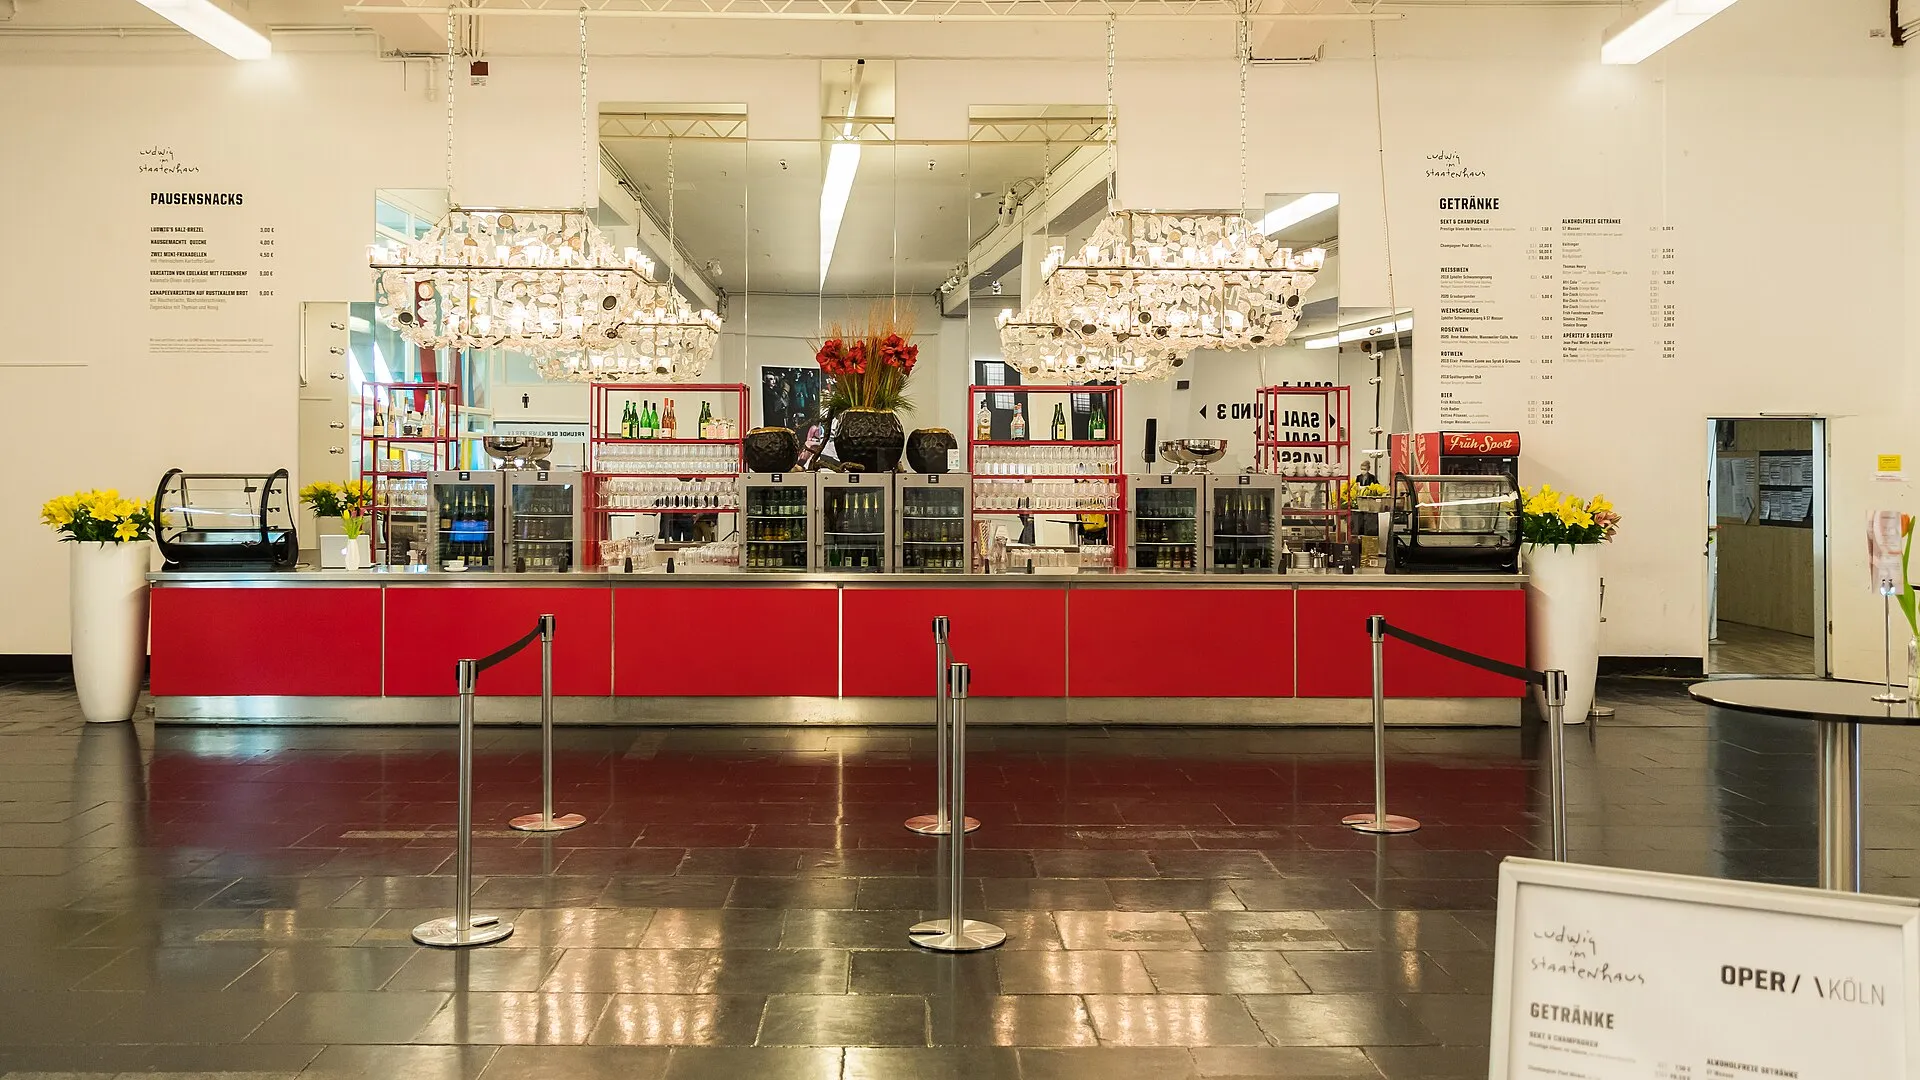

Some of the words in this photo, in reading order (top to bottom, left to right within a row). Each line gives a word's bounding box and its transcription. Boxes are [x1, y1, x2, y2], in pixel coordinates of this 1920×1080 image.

[150, 192, 243, 205] PAUSENSNACKS
[1439, 196, 1500, 210] GETRÄNKE
[1450, 434, 1479, 451] Früh
[1478, 435, 1512, 452] Sport
[1569, 945, 1586, 959] im
[1530, 1002, 1614, 1030] GETRÄNKE
[1529, 1031, 1546, 1040] SEKT
[1553, 1034, 1599, 1048] CHAMPAGNER
[1706, 1058, 1759, 1073] ALKOHOLFREIE
[1761, 1066, 1798, 1079] GETRÄNKE
